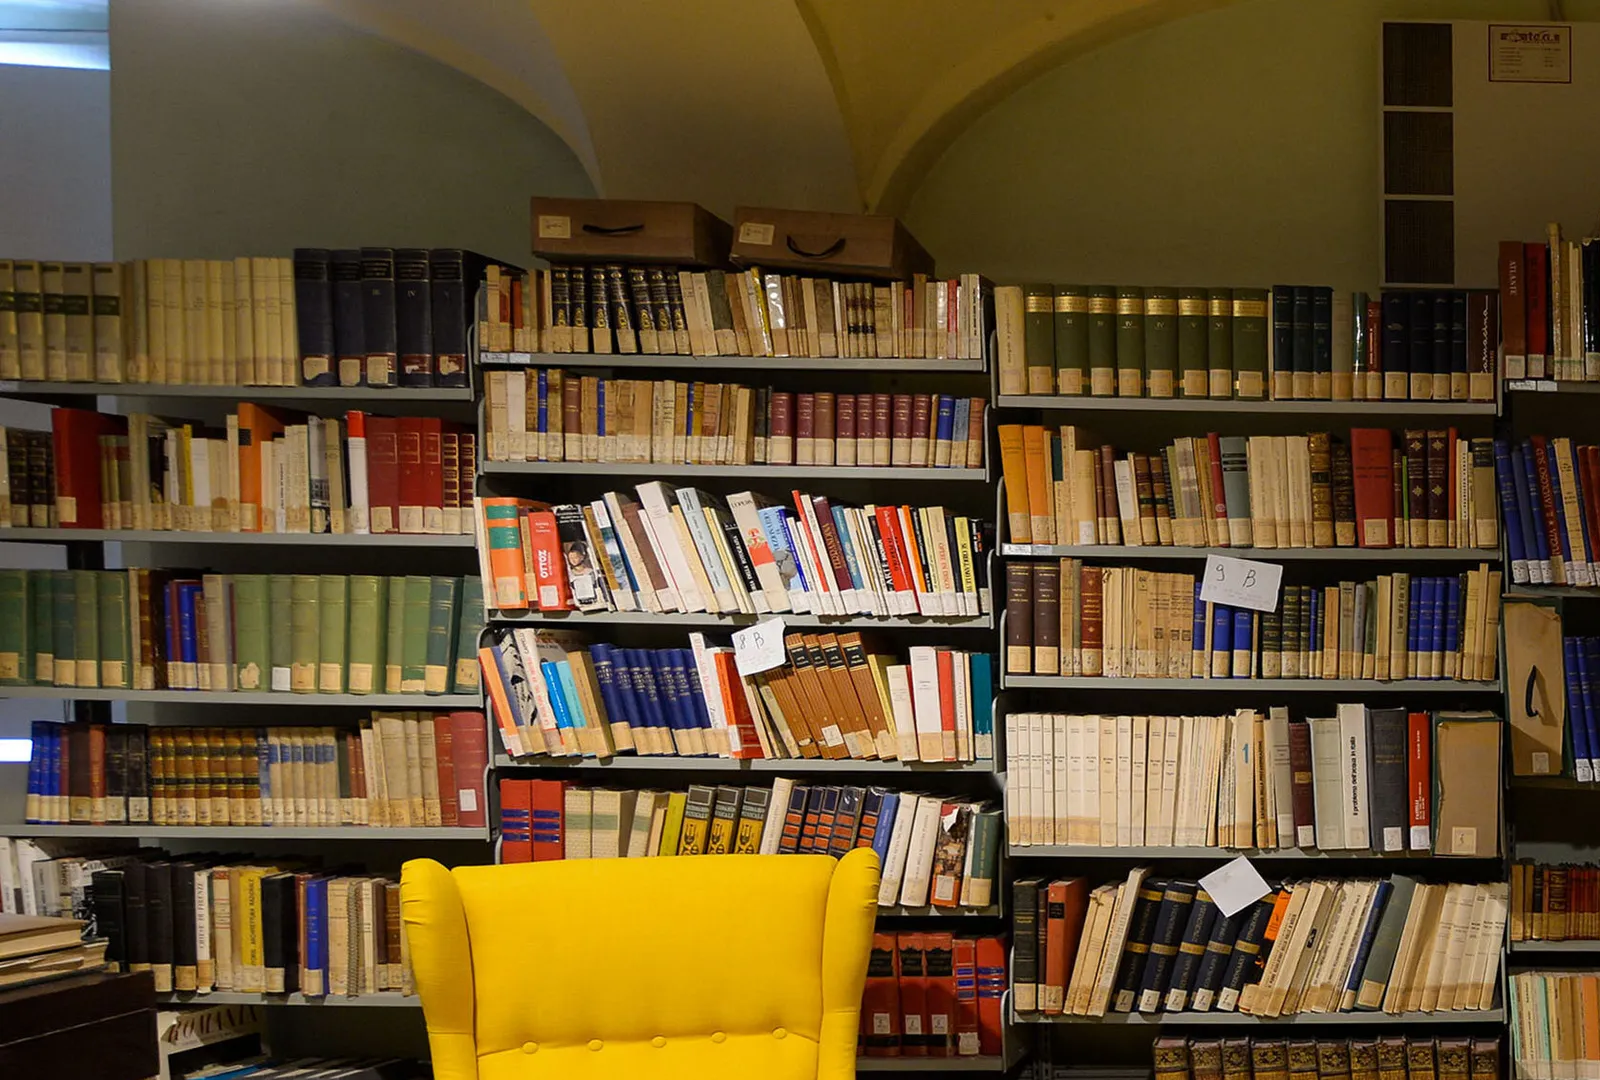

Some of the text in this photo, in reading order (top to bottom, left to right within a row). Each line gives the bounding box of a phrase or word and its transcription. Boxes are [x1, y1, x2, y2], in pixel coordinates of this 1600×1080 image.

[1505, 259, 1520, 296] ATLANTE
[1535, 447, 1545, 465] SUD
[1242, 569, 1257, 588] B
[754, 631, 765, 650] B
[1241, 743, 1249, 764] 1
